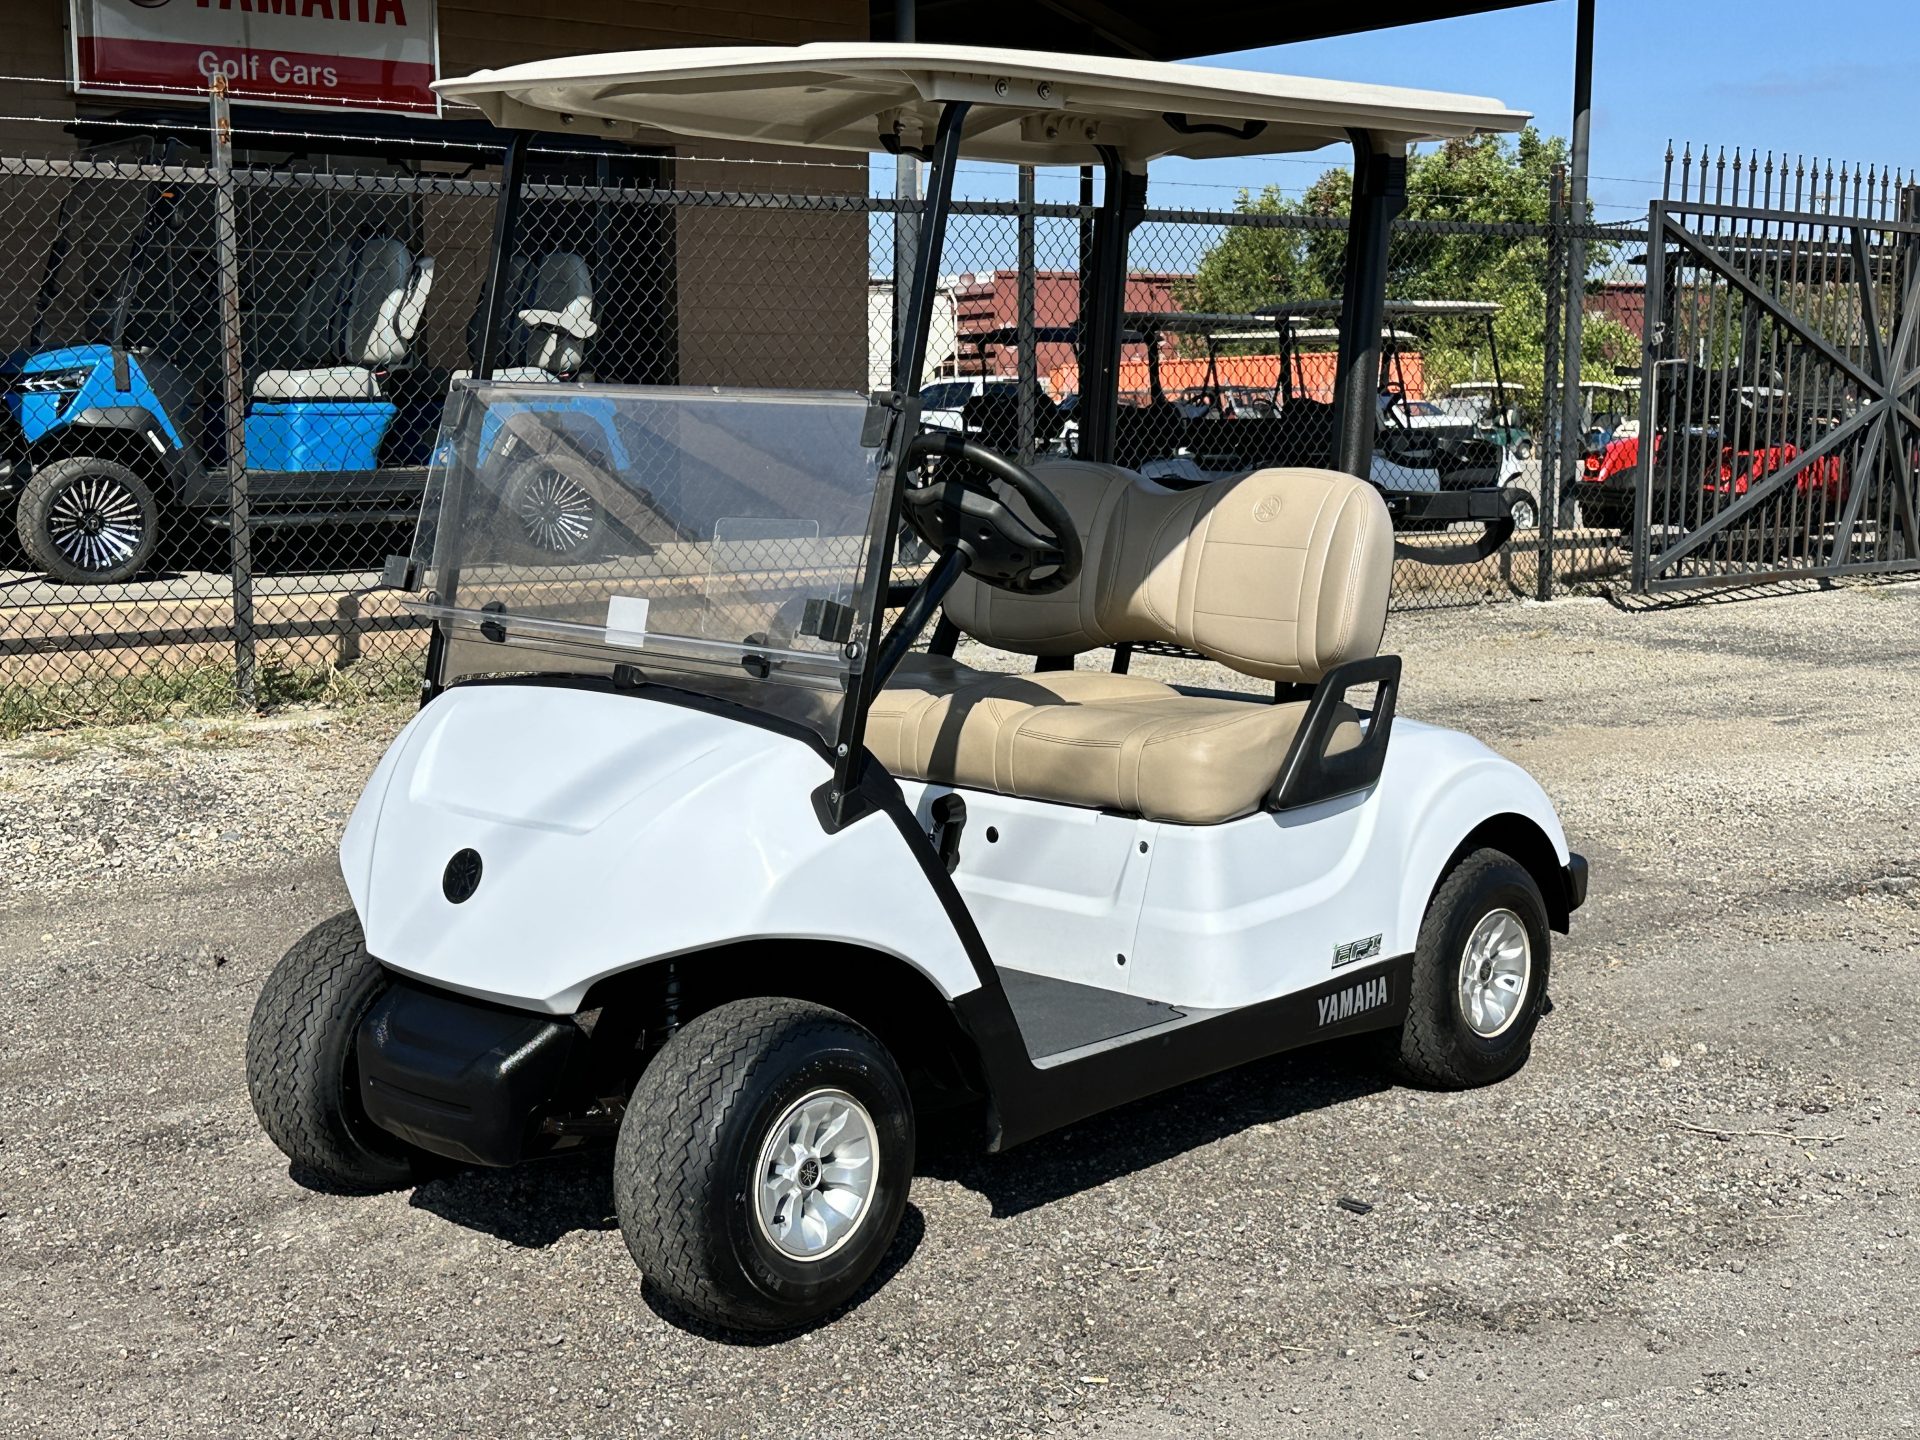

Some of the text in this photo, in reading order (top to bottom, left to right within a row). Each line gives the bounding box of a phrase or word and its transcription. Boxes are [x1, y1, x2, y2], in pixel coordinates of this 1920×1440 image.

[198, 51, 338, 87] Golf Cars
[1318, 976, 1387, 1026] YAMAHA
